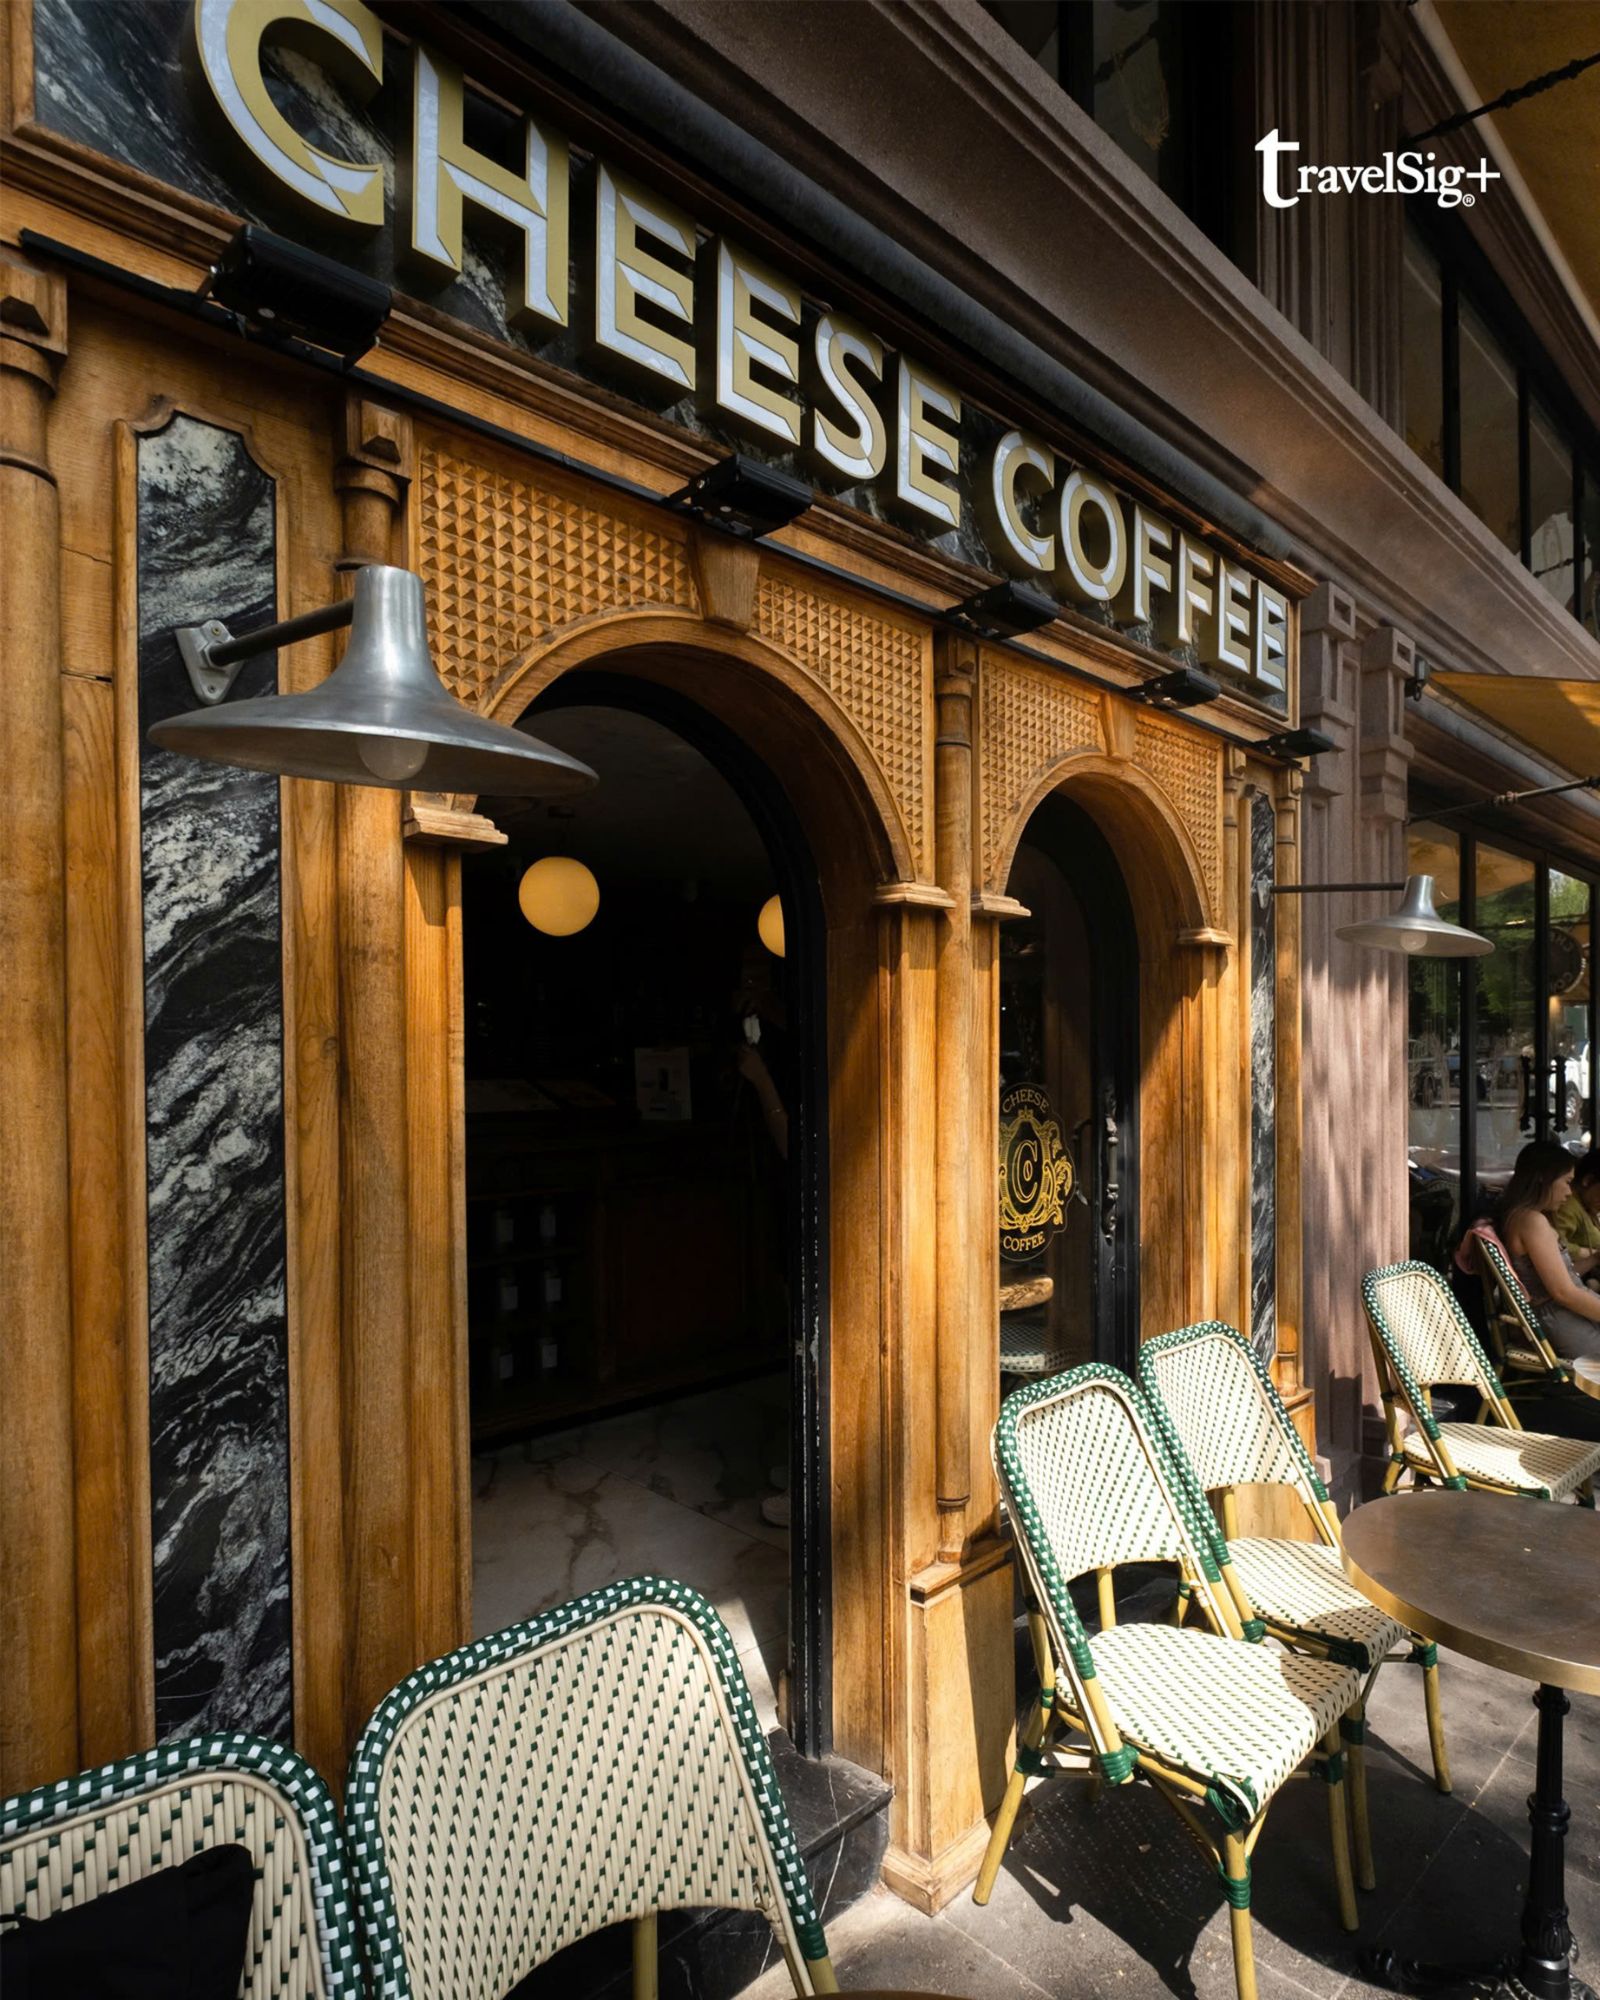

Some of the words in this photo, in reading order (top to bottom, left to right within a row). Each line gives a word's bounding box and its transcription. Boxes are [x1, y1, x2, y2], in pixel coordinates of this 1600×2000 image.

[195, 0, 962, 530] CHEESE
[993, 430, 1287, 693] COFFEE
[1002, 1089, 1049, 1113] CHEESE
[1003, 1231, 1045, 1251] COFFEE
